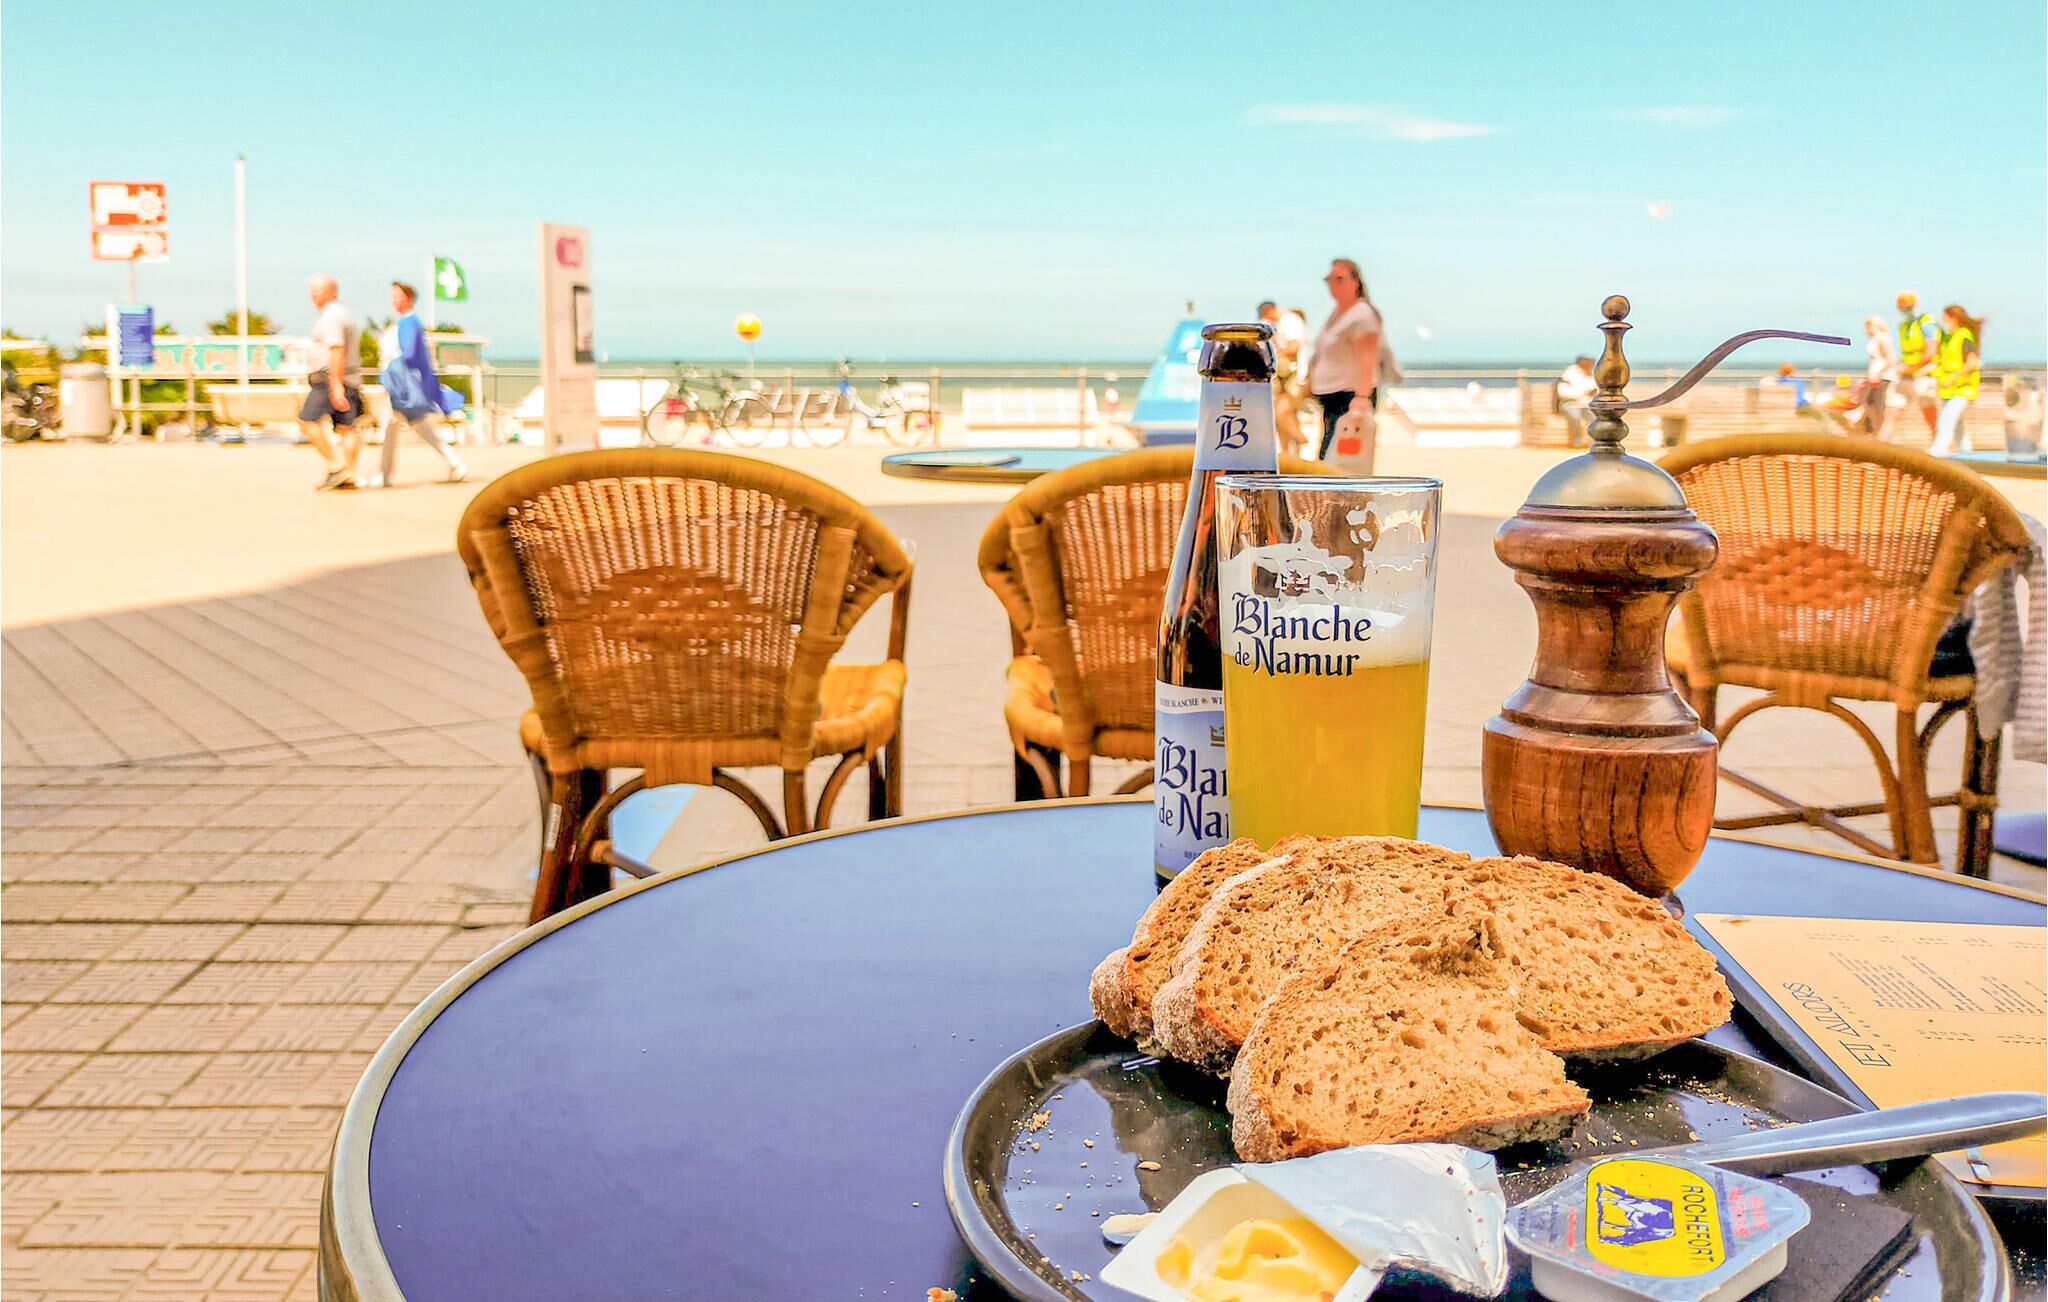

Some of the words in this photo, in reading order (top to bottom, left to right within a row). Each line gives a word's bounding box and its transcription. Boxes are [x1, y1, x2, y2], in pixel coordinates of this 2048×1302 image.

[1214, 414, 1250, 451] B
[1231, 592, 1372, 643] Blanche
[1234, 642, 1251, 667] de
[1252, 636, 1360, 678] Namur
[1158, 796, 1174, 826] de
[1176, 791, 1230, 841] Na
[1782, 981, 1860, 1038] ALORS
[1840, 1039, 1892, 1068] ET
[1680, 1184, 1714, 1263] ROCHEFORT
